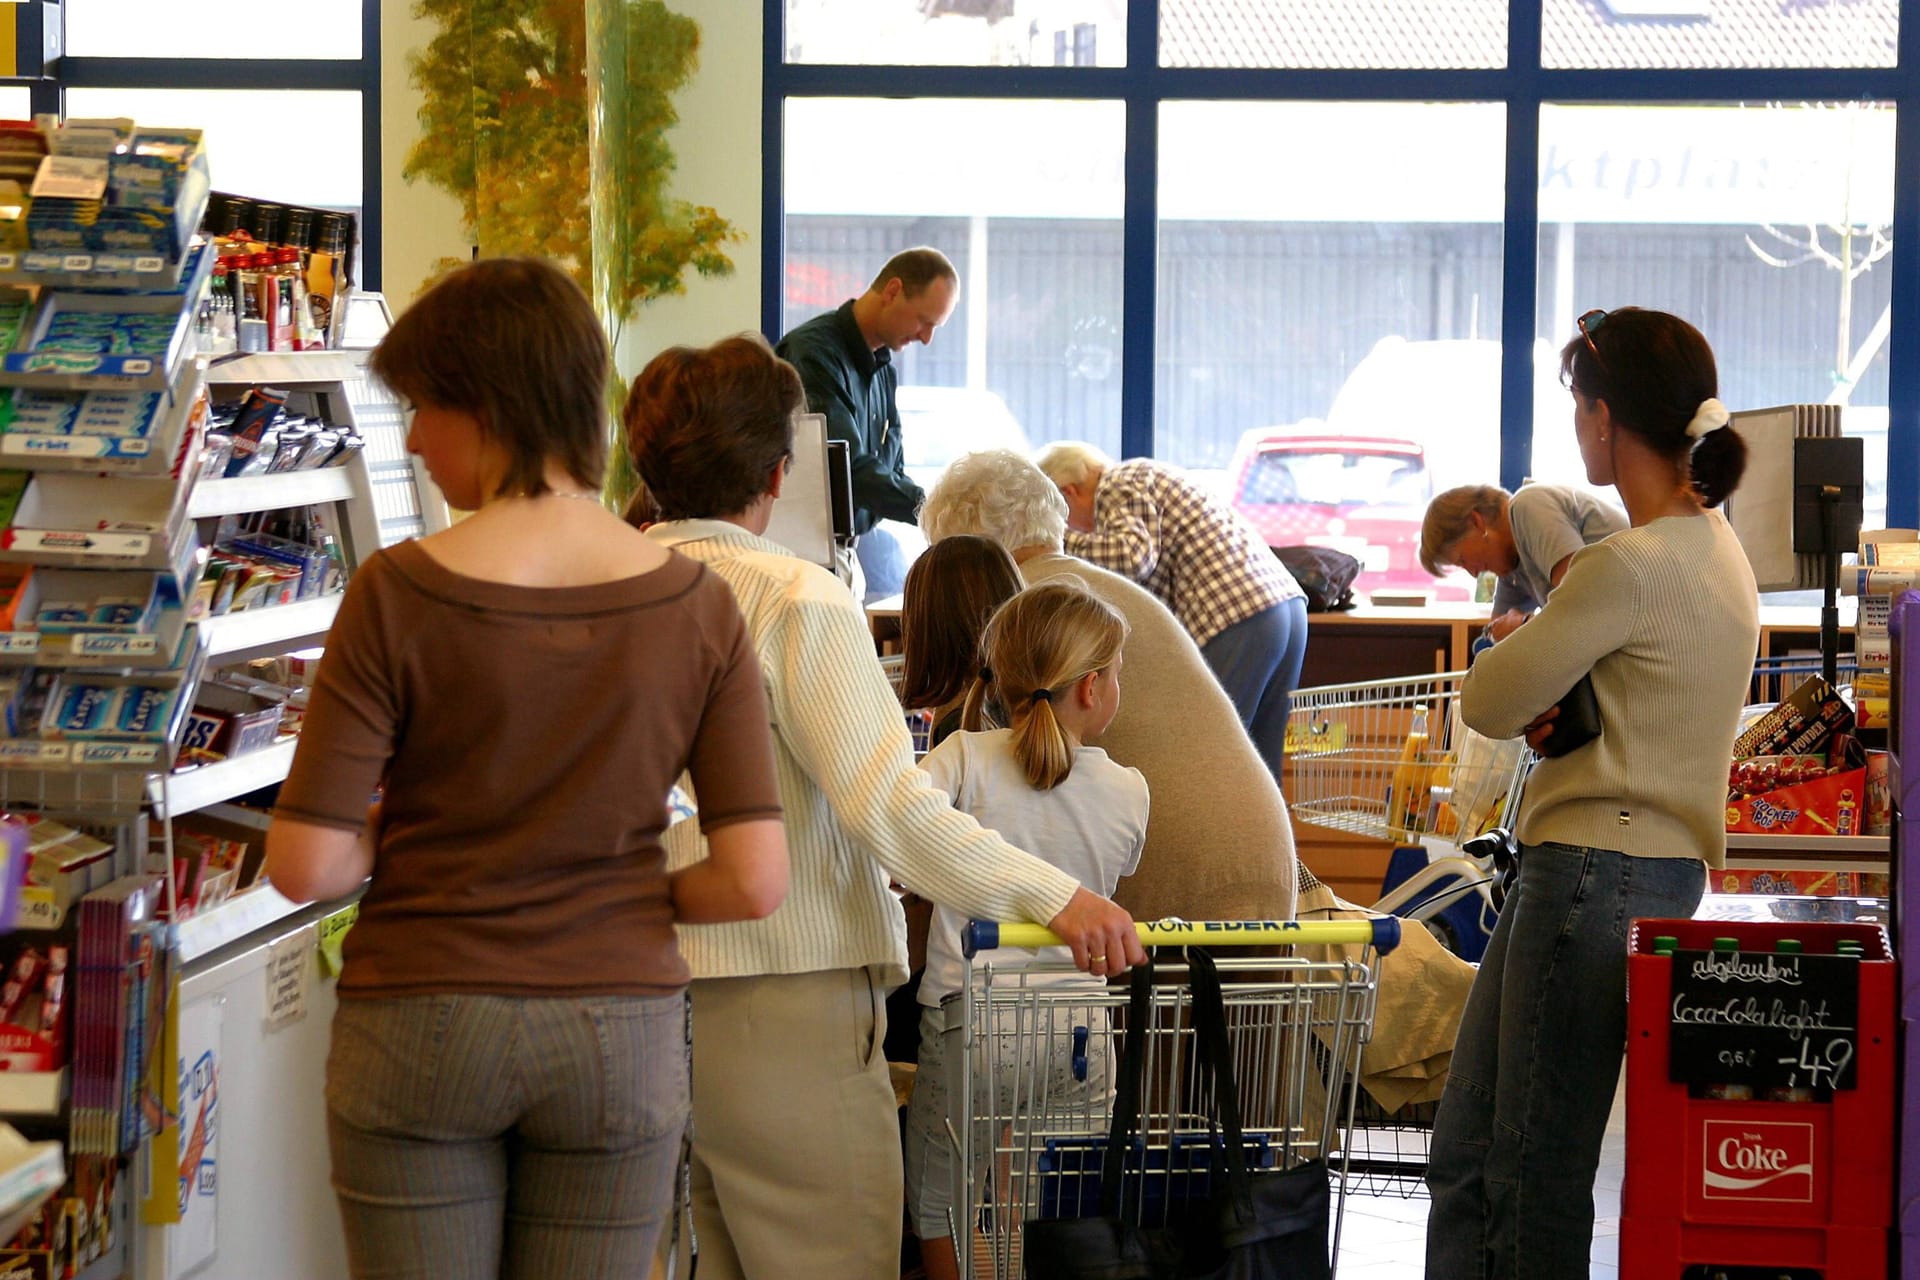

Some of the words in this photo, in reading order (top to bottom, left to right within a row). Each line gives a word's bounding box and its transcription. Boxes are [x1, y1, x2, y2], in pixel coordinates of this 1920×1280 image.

[1791, 721, 1827, 753] POWDER
[1145, 921, 1194, 933] VON
[1205, 921, 1301, 932] EDEKA
[1768, 997, 1831, 1040] light
[1718, 1138, 1788, 1171] Coke
